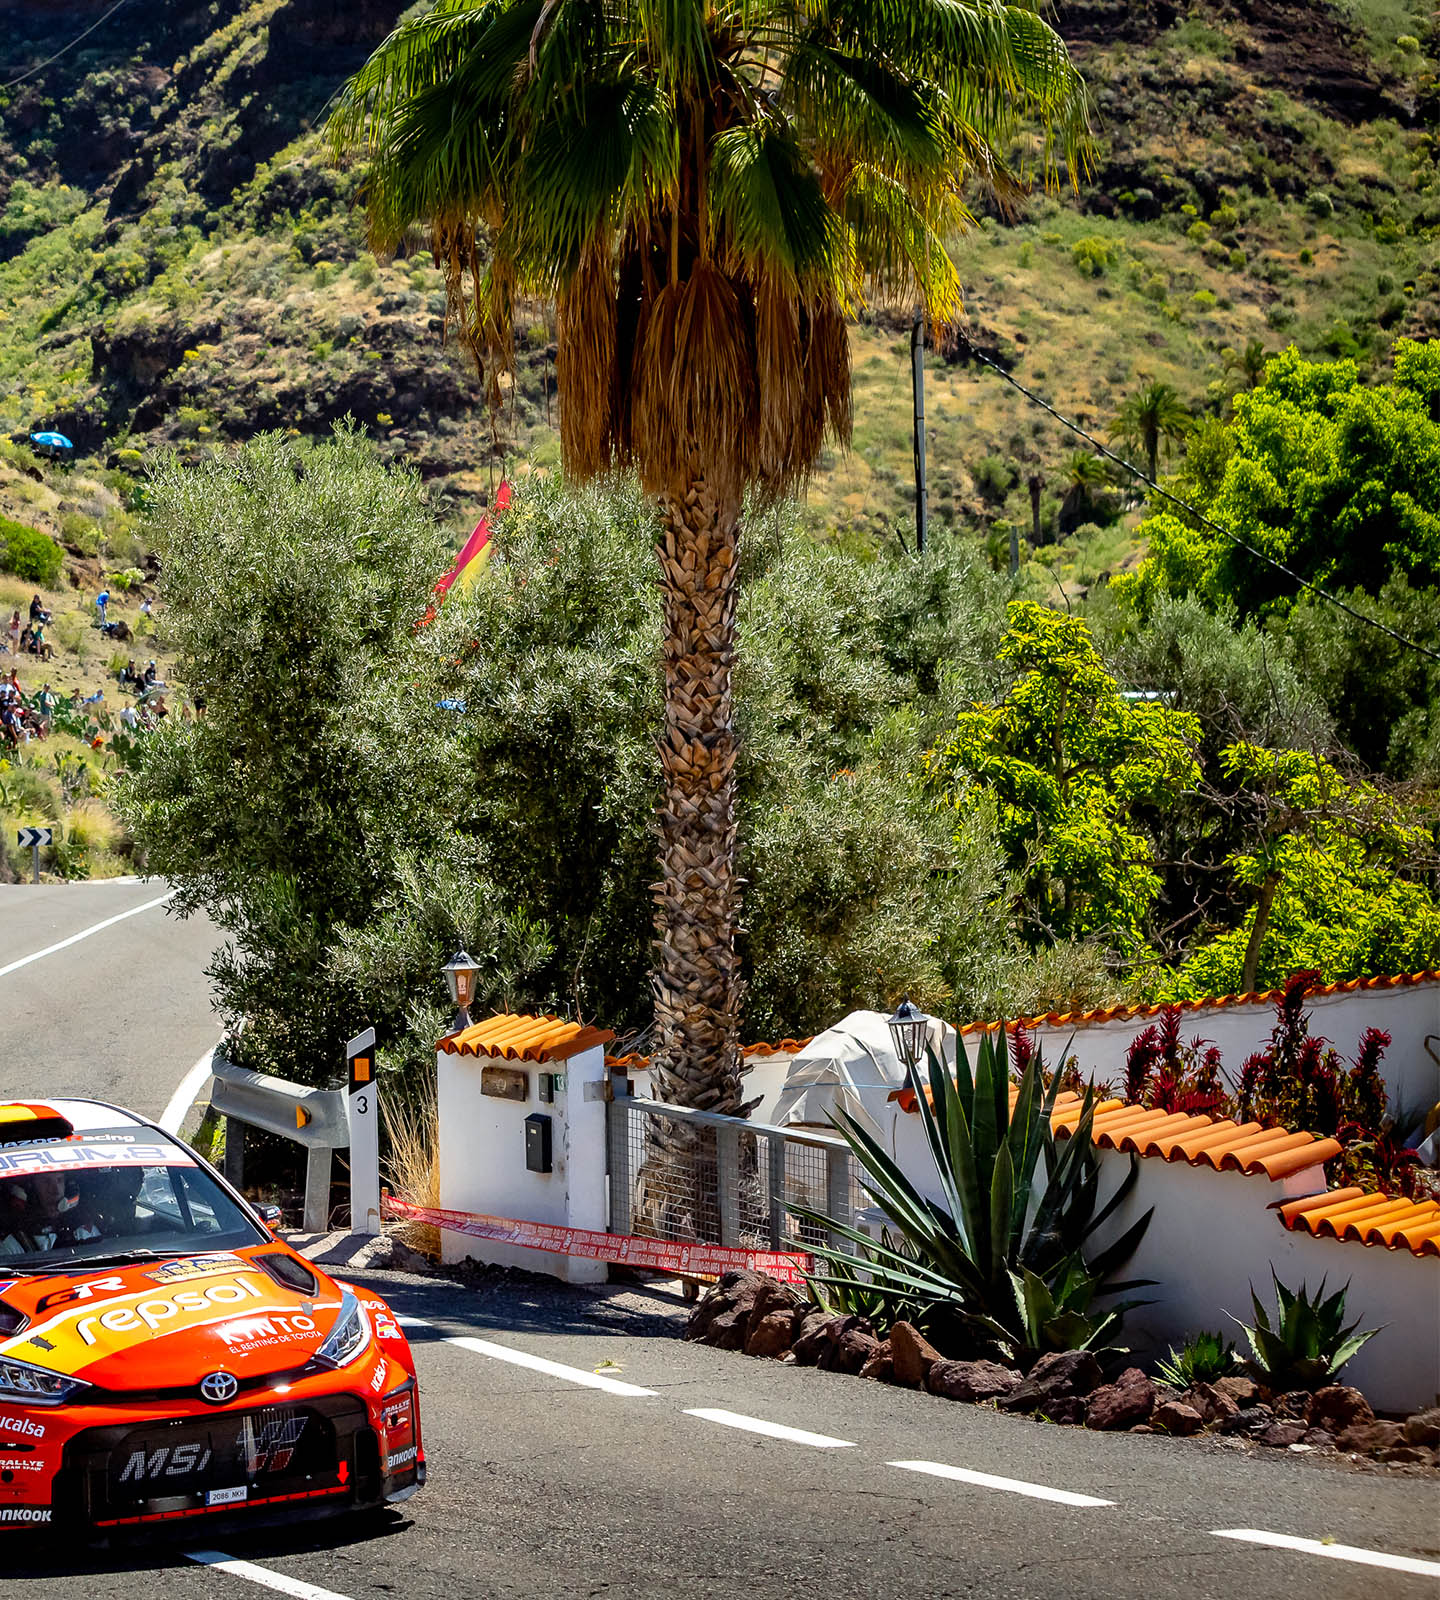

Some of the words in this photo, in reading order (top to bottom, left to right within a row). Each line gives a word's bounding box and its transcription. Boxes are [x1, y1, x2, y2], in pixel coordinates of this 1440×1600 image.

[357, 1095, 368, 1115] 3
[65, 1134, 136, 1145] Racing
[36, 1276, 127, 1314] GR
[76, 1277, 263, 1347] repsol
[229, 1346, 241, 1354] EL
[241, 1338, 279, 1351] RENTING
[278, 1334, 291, 1343] DE
[291, 1331, 324, 1341] TOYOTA
